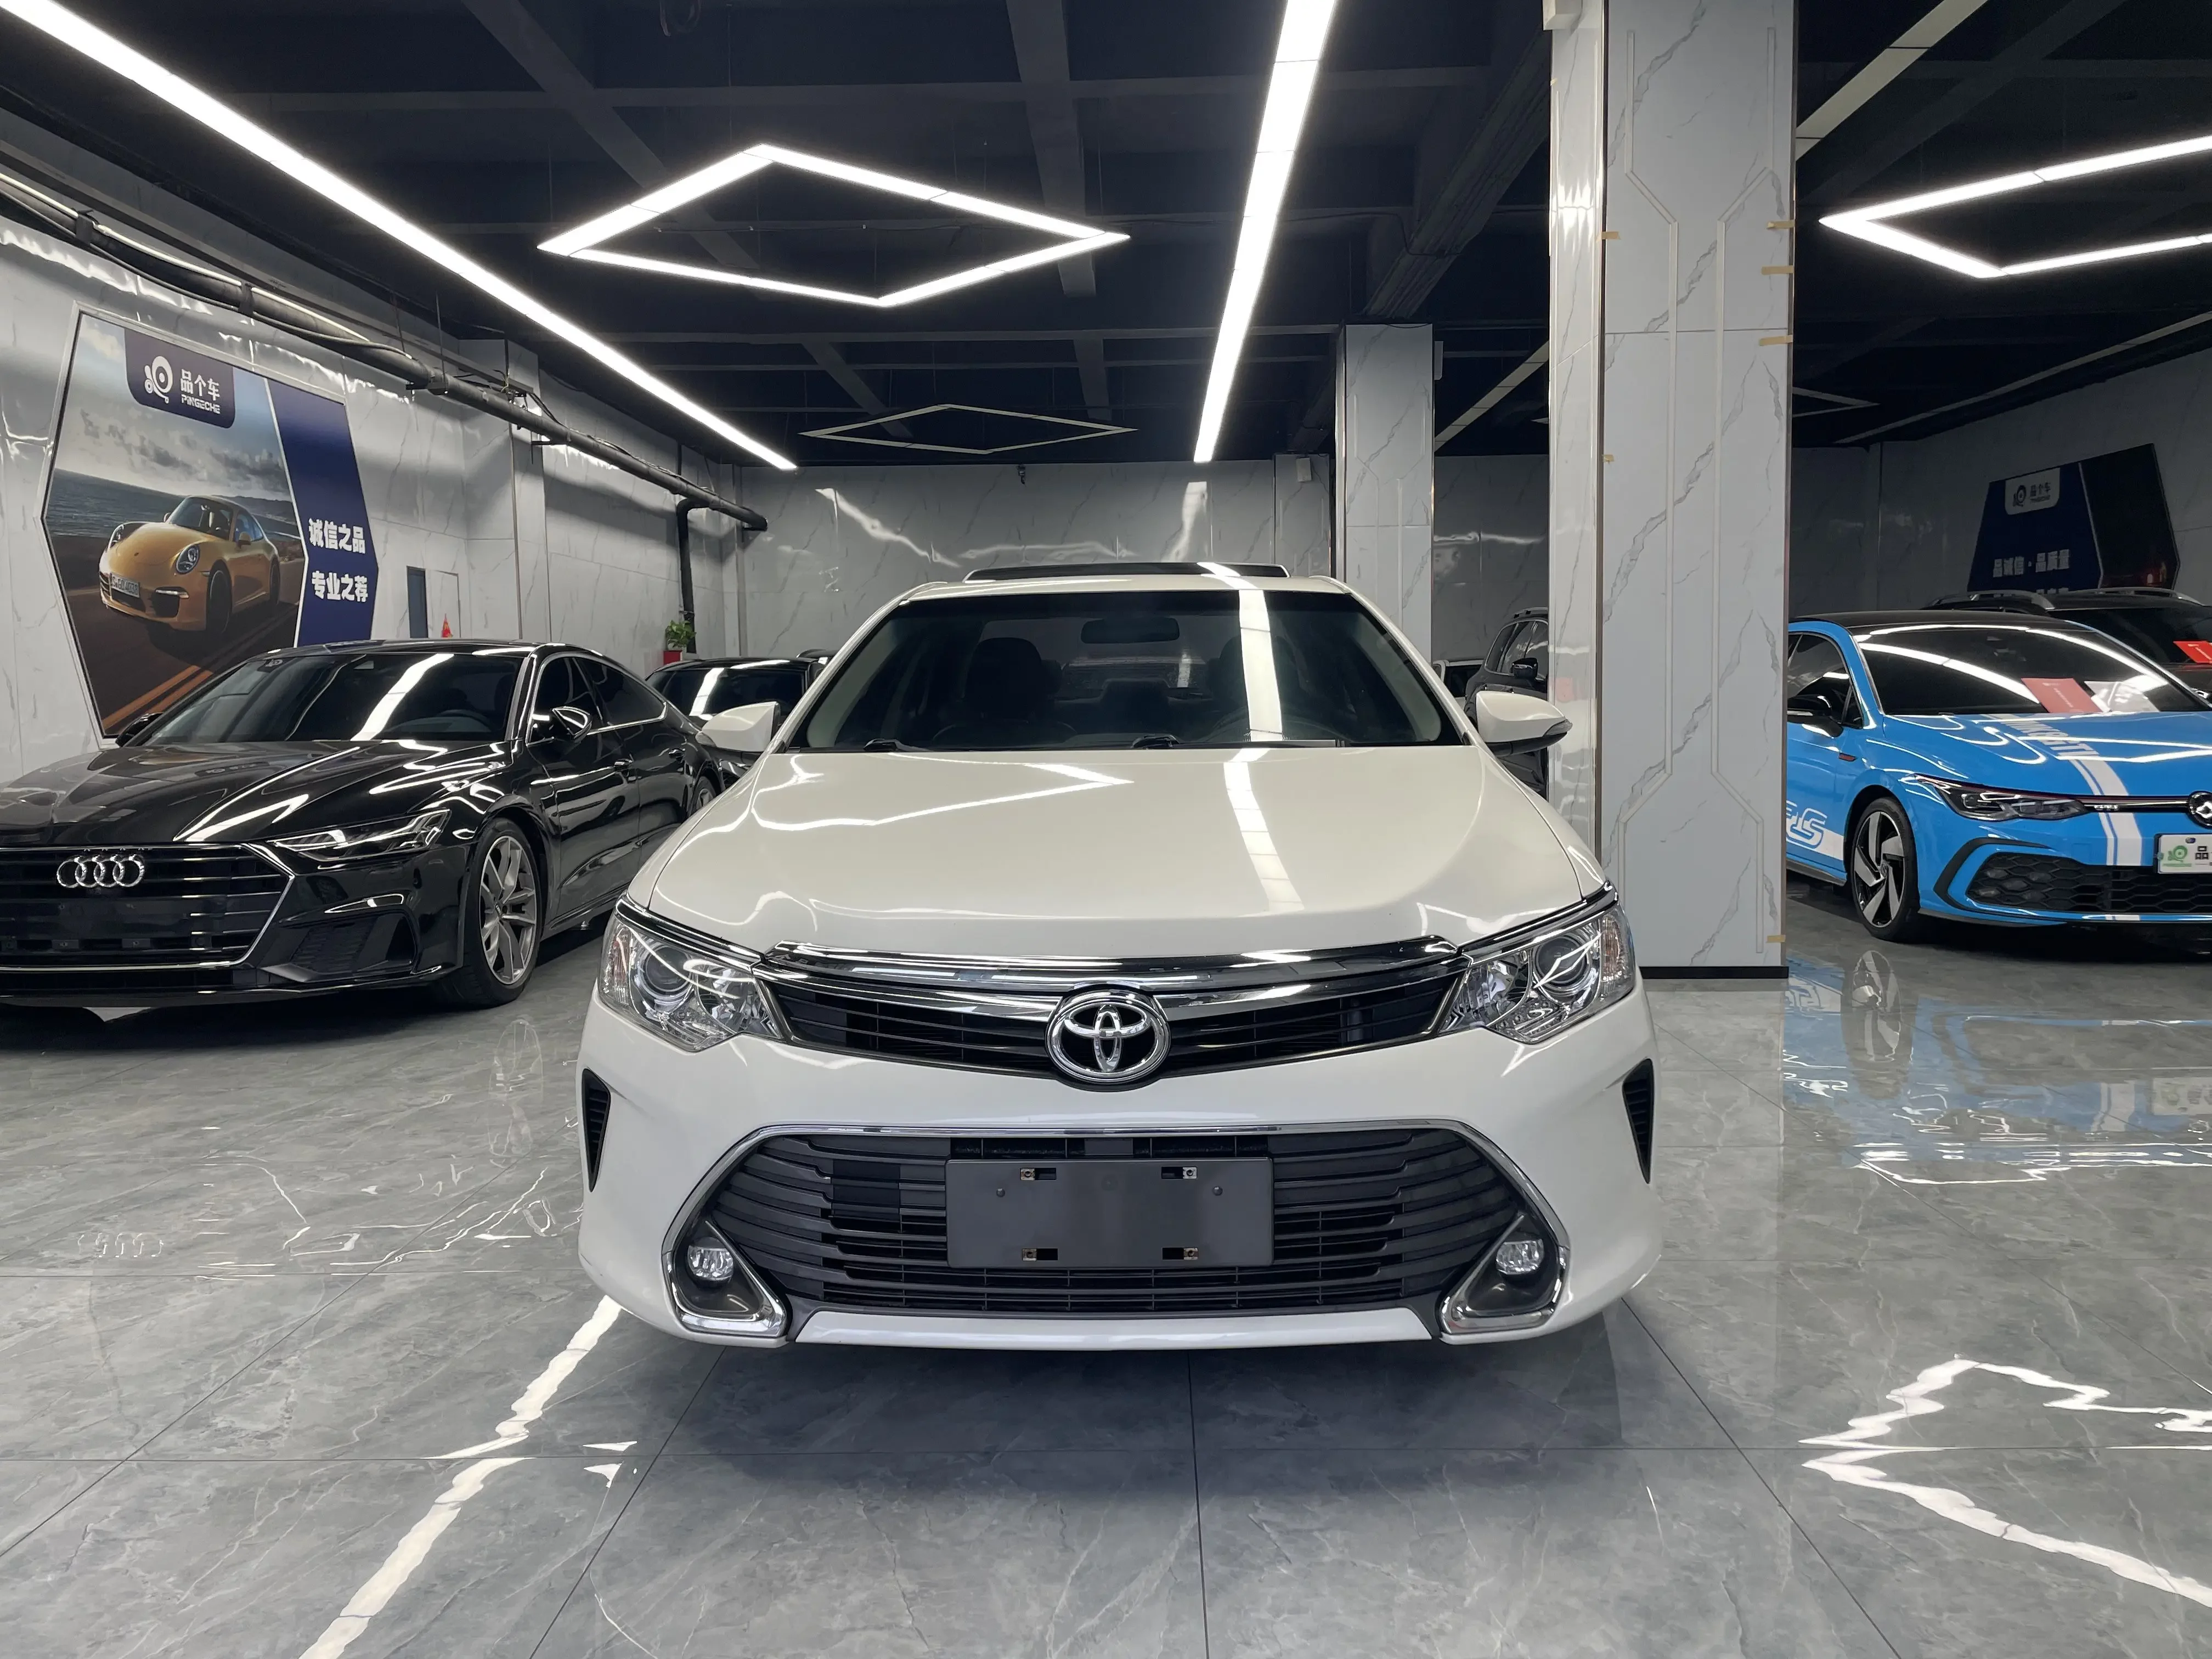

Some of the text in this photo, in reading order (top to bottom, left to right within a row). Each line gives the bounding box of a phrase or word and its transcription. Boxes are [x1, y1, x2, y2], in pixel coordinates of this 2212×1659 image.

[180, 369, 220, 401] 品个车
[308, 518, 365, 554] 诚信之品
[312, 571, 368, 602] 专业之荐
